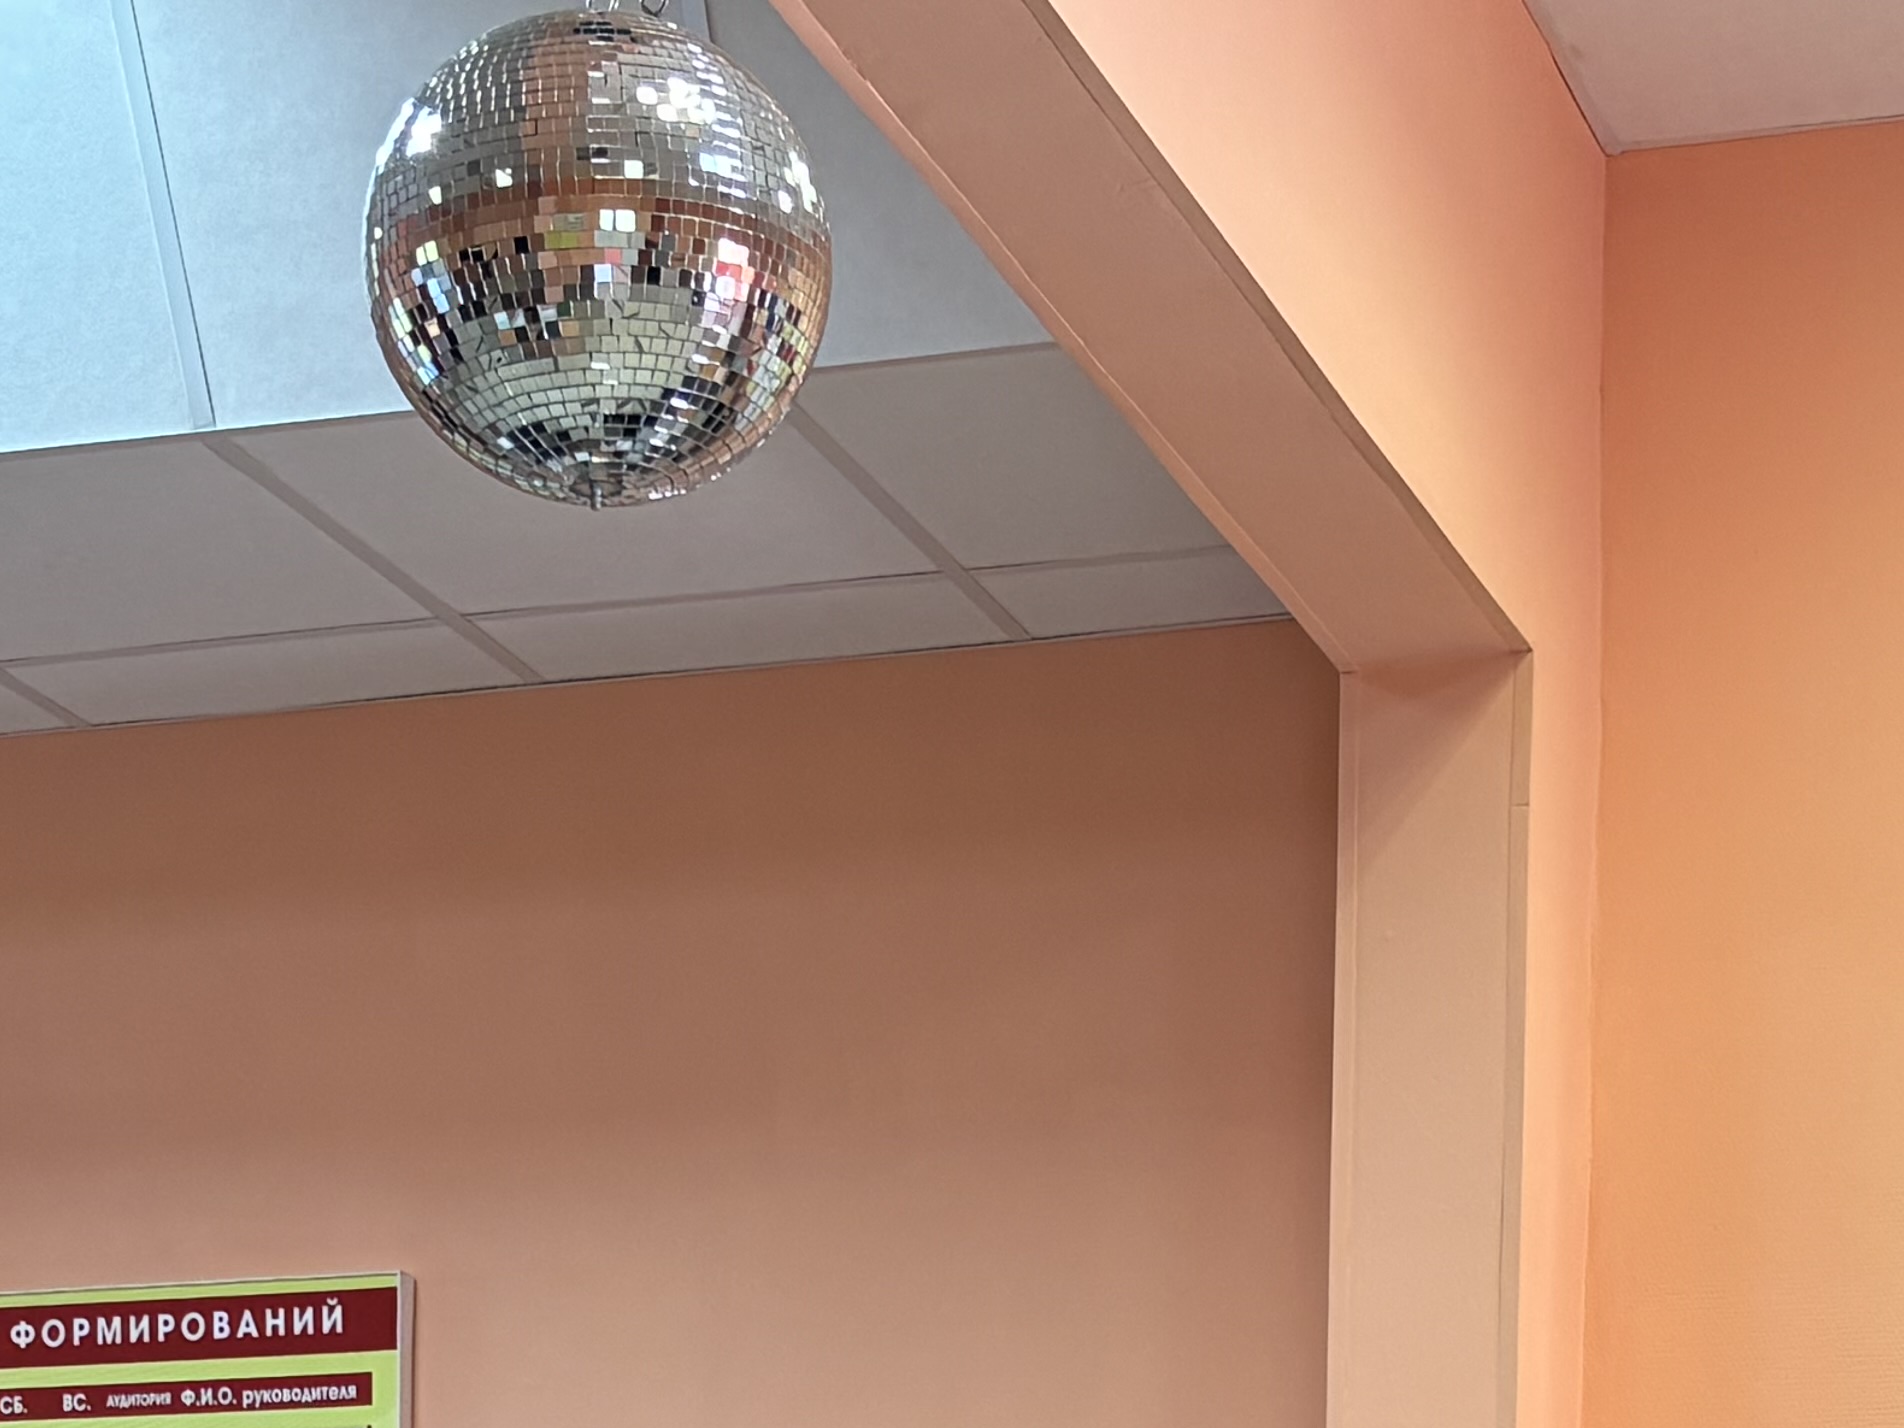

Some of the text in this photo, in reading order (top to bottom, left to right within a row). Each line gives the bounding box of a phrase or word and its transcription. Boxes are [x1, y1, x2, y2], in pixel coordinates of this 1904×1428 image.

[9, 1297, 344, 1349] ФОРМИРОВАНИЙ
[0, 1396, 28, 1414] СБ.
[63, 1393, 91, 1412] ВС.
[106, 1392, 172, 1408] АУДИТОРИЯ
[181, 1387, 237, 1407] Ф.И.О.
[242, 1385, 357, 1410] руководителя
